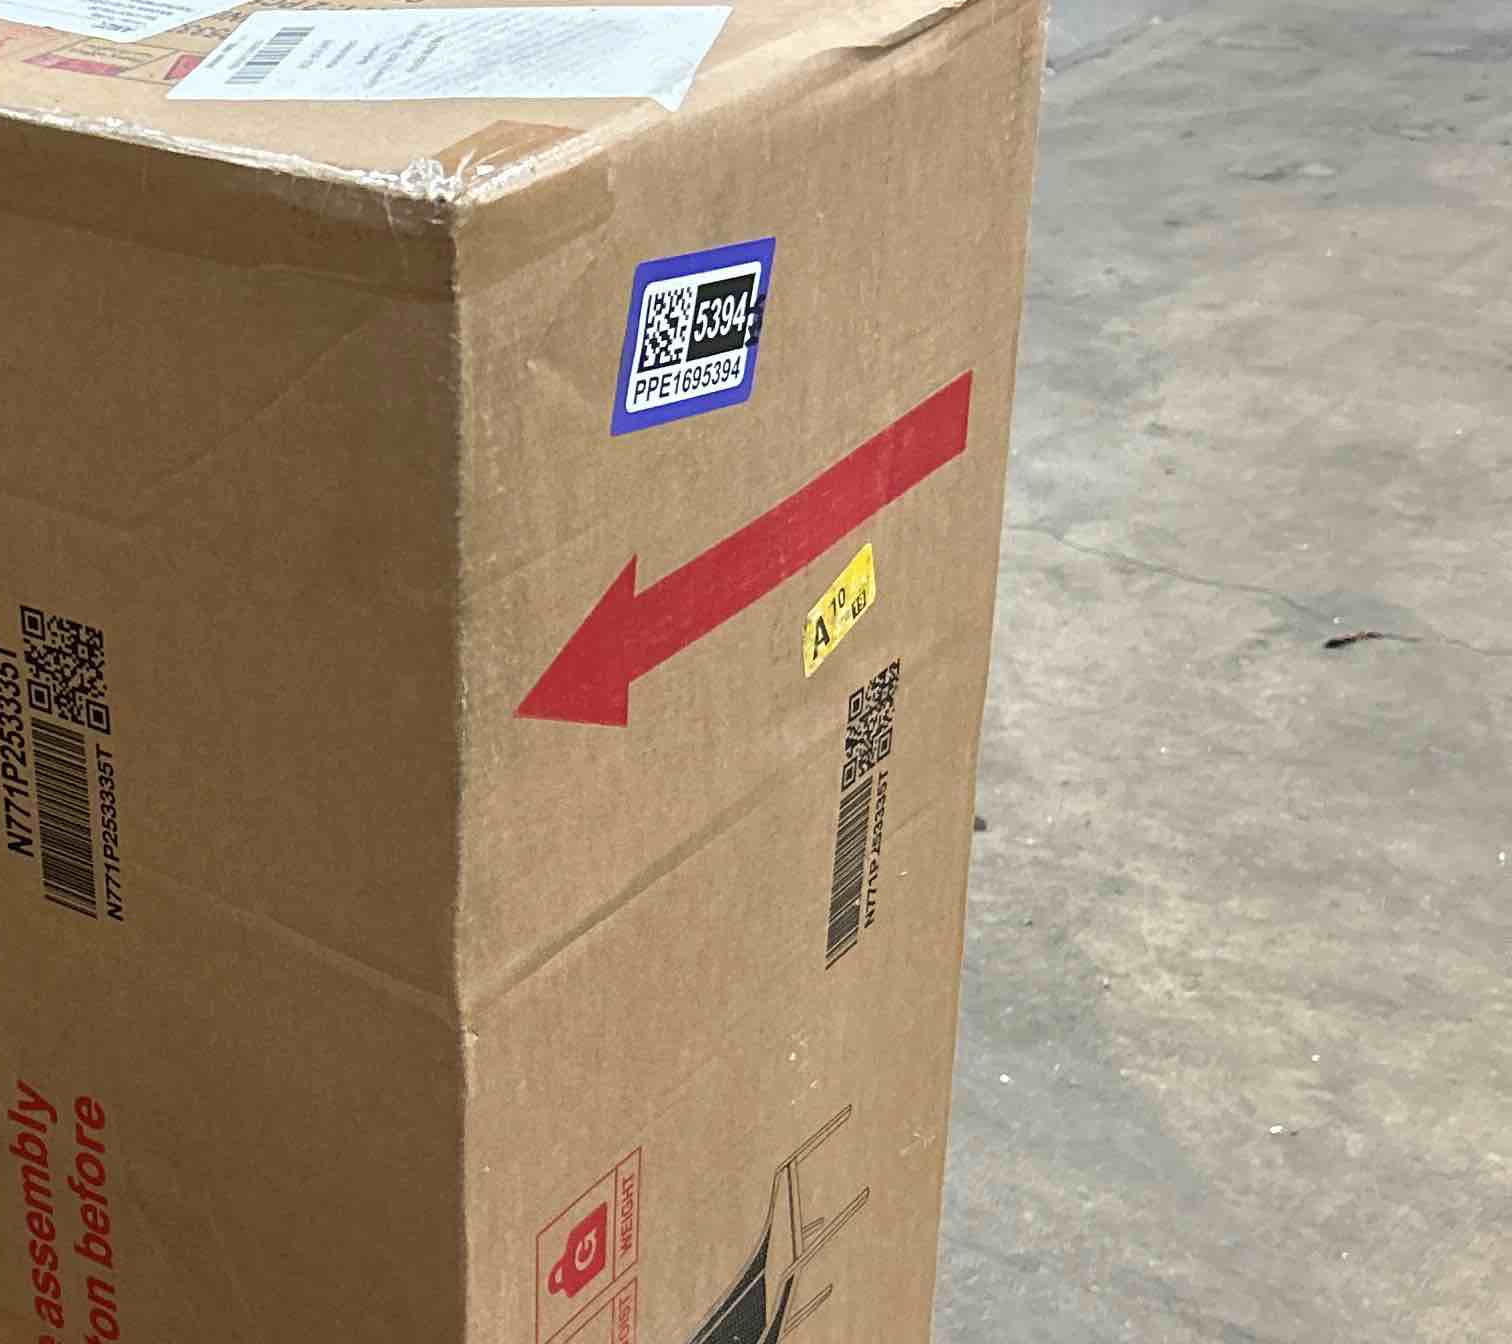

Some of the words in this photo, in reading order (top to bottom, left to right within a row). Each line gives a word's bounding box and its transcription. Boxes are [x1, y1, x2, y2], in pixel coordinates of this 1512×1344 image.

[694, 292, 748, 342] 5394
[634, 356, 741, 404] PPE1695394
[813, 616, 830, 660] A
[831, 588, 846, 616] 10
[96, 744, 124, 921] N771P253335T
[8, 1079, 61, 1329] assembly
[67, 1096, 114, 1269] before
[619, 1172, 635, 1255] WEIGHT
